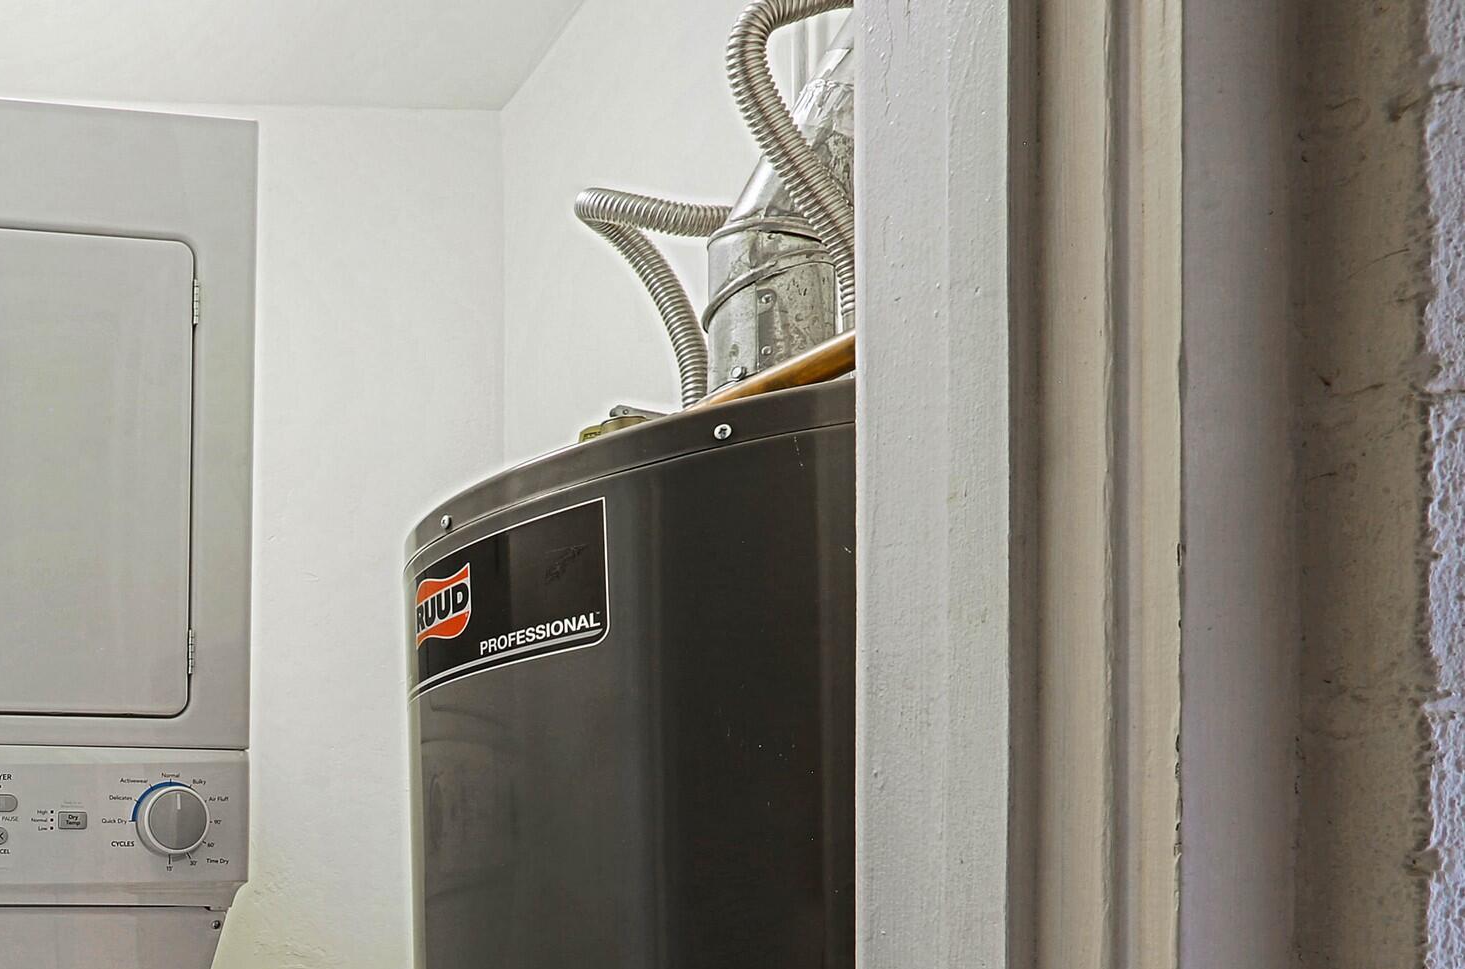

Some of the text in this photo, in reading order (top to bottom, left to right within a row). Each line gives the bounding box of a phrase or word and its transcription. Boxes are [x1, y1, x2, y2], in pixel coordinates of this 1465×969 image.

[416, 582, 469, 633] RUUD
[480, 612, 602, 656] PROFESSIONAL
[192, 778, 207, 786] Bulky
